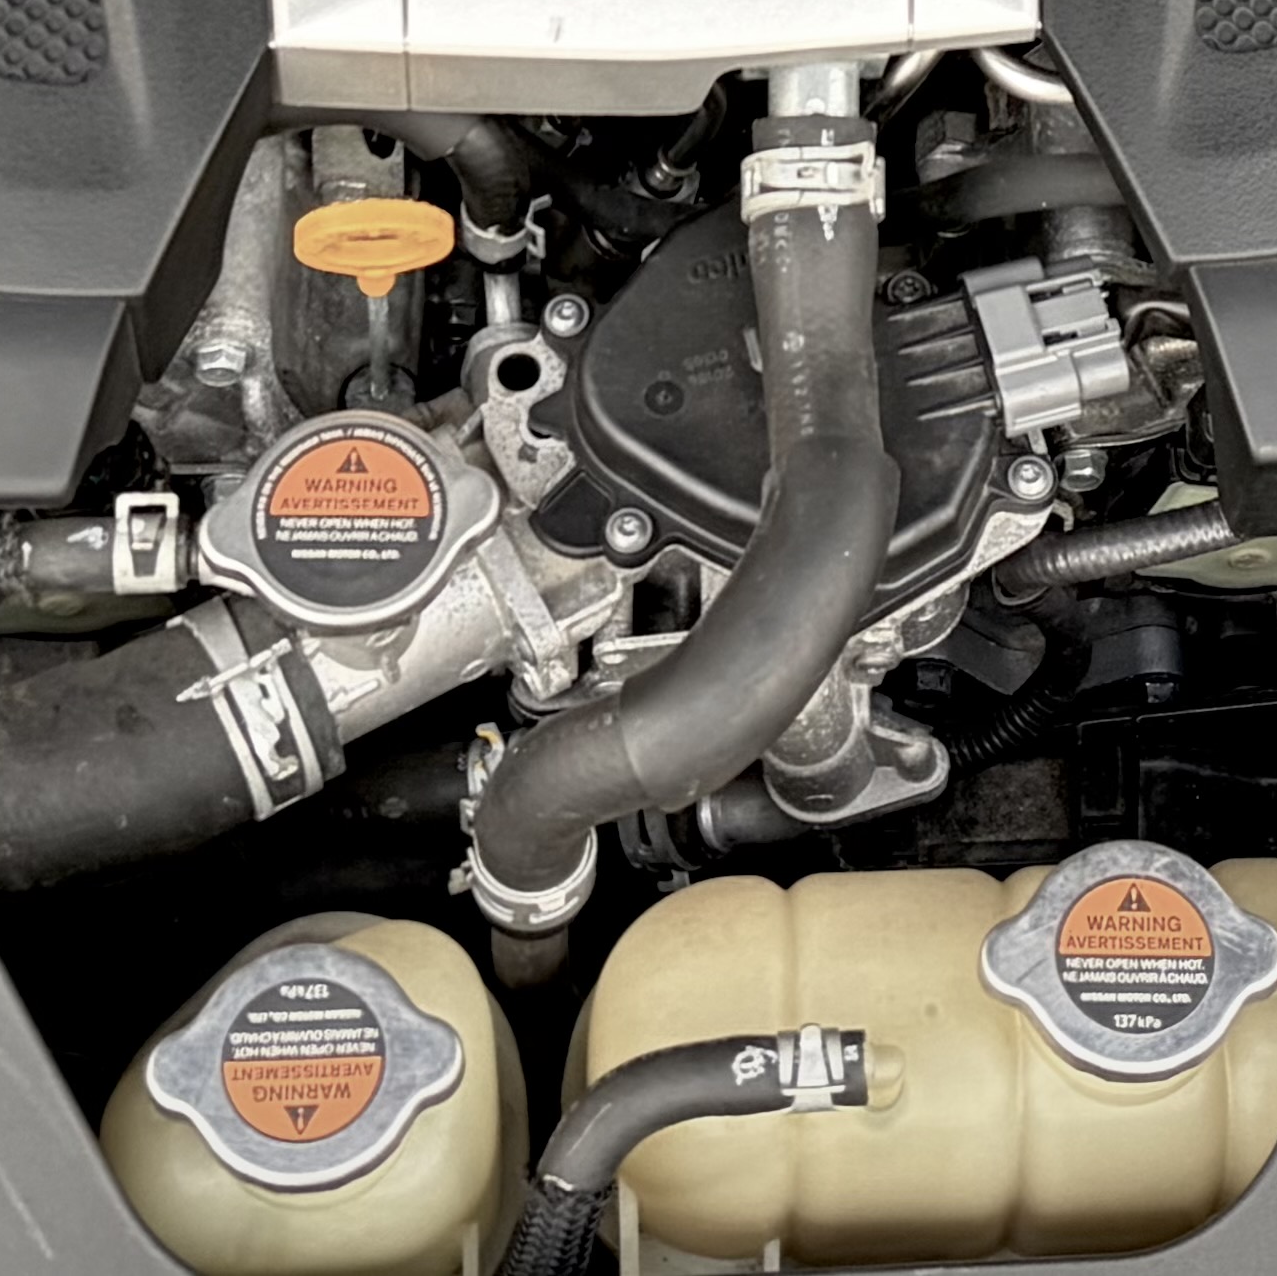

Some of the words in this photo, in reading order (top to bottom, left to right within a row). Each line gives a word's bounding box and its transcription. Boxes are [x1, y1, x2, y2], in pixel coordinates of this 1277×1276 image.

[305, 479, 397, 493] WARNING
[280, 498, 420, 510] AVERTISSEMENT
[280, 518, 317, 529] NEVER
[320, 518, 352, 529] OPEN
[353, 518, 388, 529] WHEN
[1087, 916, 1182, 932] WARNING
[1066, 936, 1204, 951] AVERTISSEMENT
[1066, 958, 1104, 969] NEVER
[1106, 958, 1138, 969] OPEN
[1140, 959, 1176, 969] WHEN
[1179, 959, 1205, 970] HOT.
[1063, 971, 1079, 982] NE
[1079, 972, 1116, 983] JAMAIS
[1118, 972, 1158, 983] OUVRIR
[261, 1045, 299, 1058] WHEN
[300, 1043, 335, 1055] OPEN
[336, 1042, 375, 1054] NEVER
[232, 1063, 374, 1081] AVERTISSEMENT
[252, 1082, 351, 1103] WARNING
